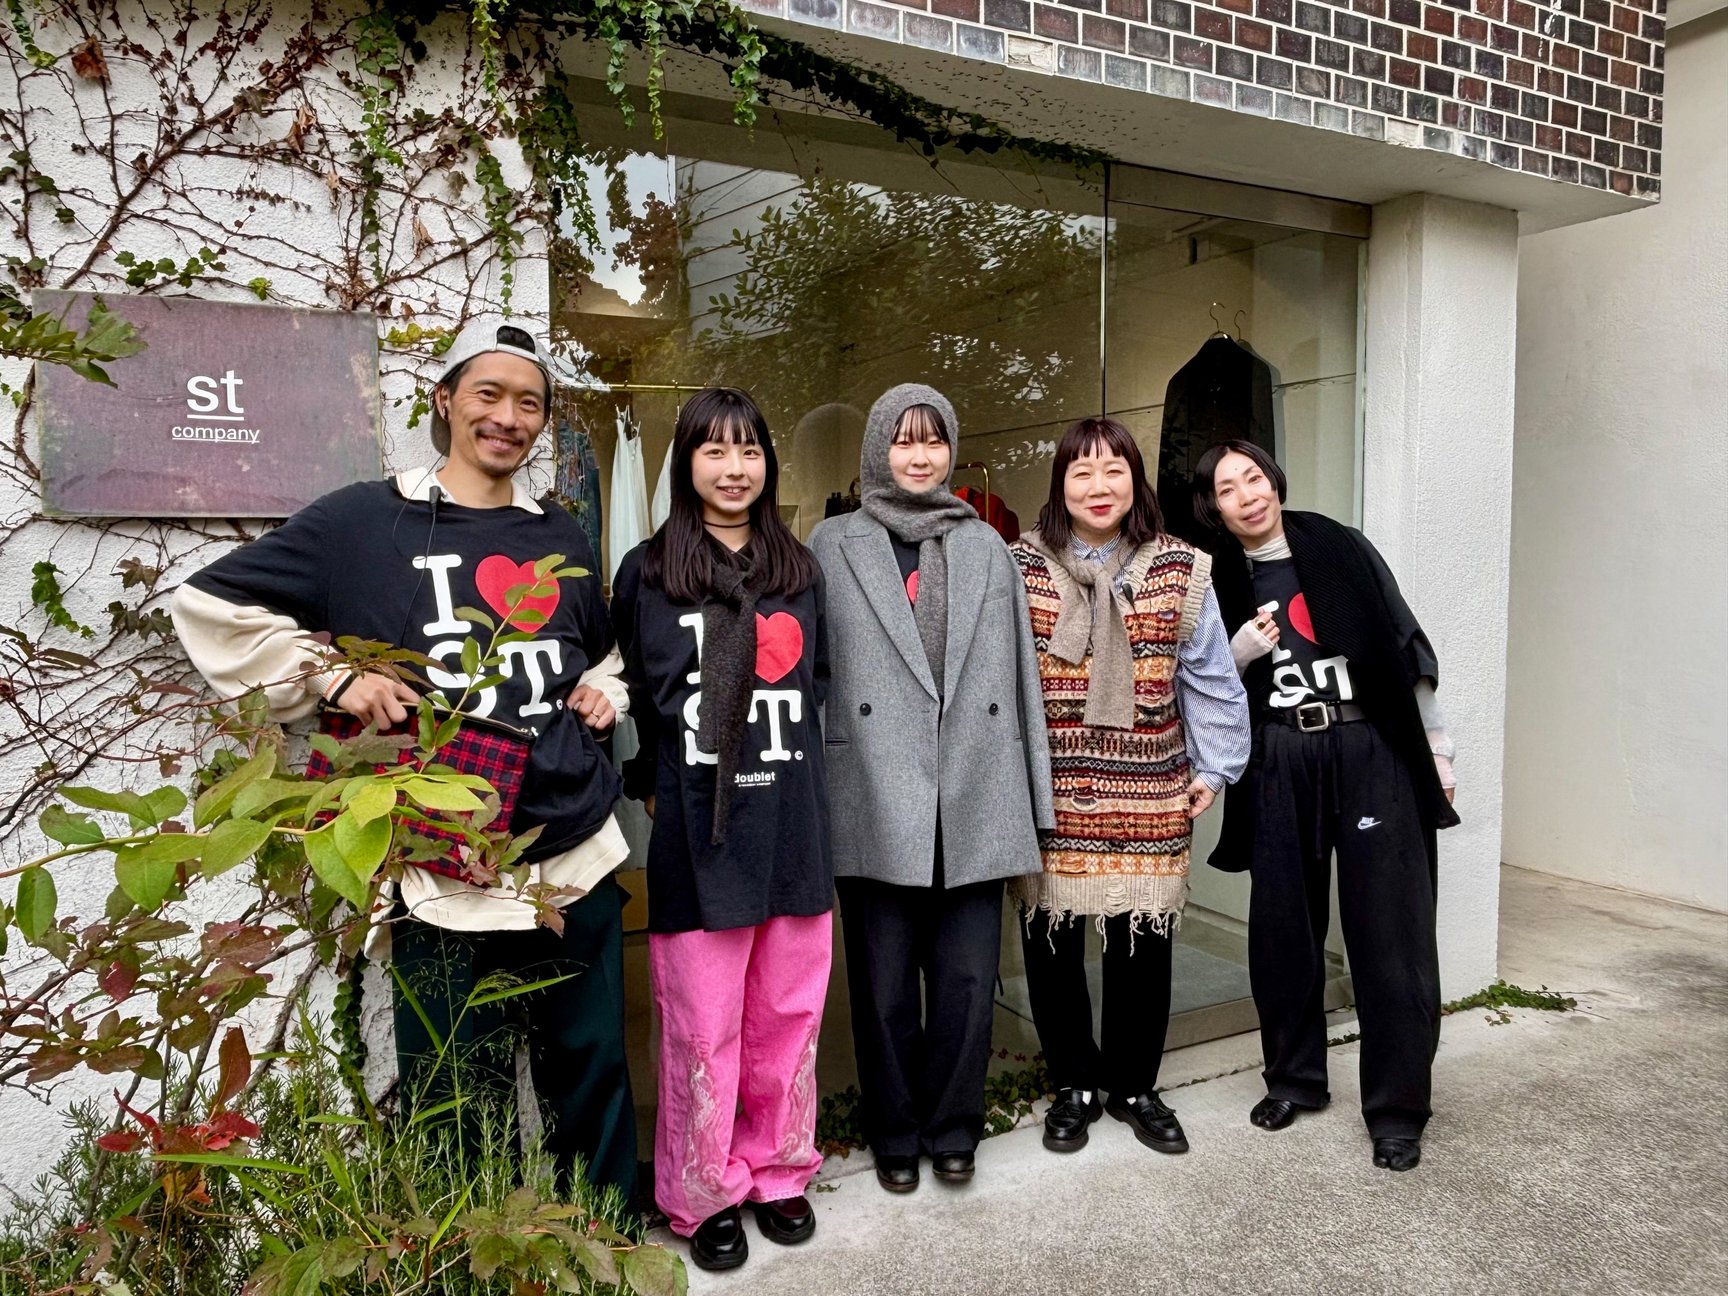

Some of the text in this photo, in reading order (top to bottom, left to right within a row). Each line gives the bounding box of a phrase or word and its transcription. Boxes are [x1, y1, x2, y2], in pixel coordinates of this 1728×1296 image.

[187, 370, 244, 414] st
[172, 425, 260, 444] company
[412, 553, 472, 636] I
